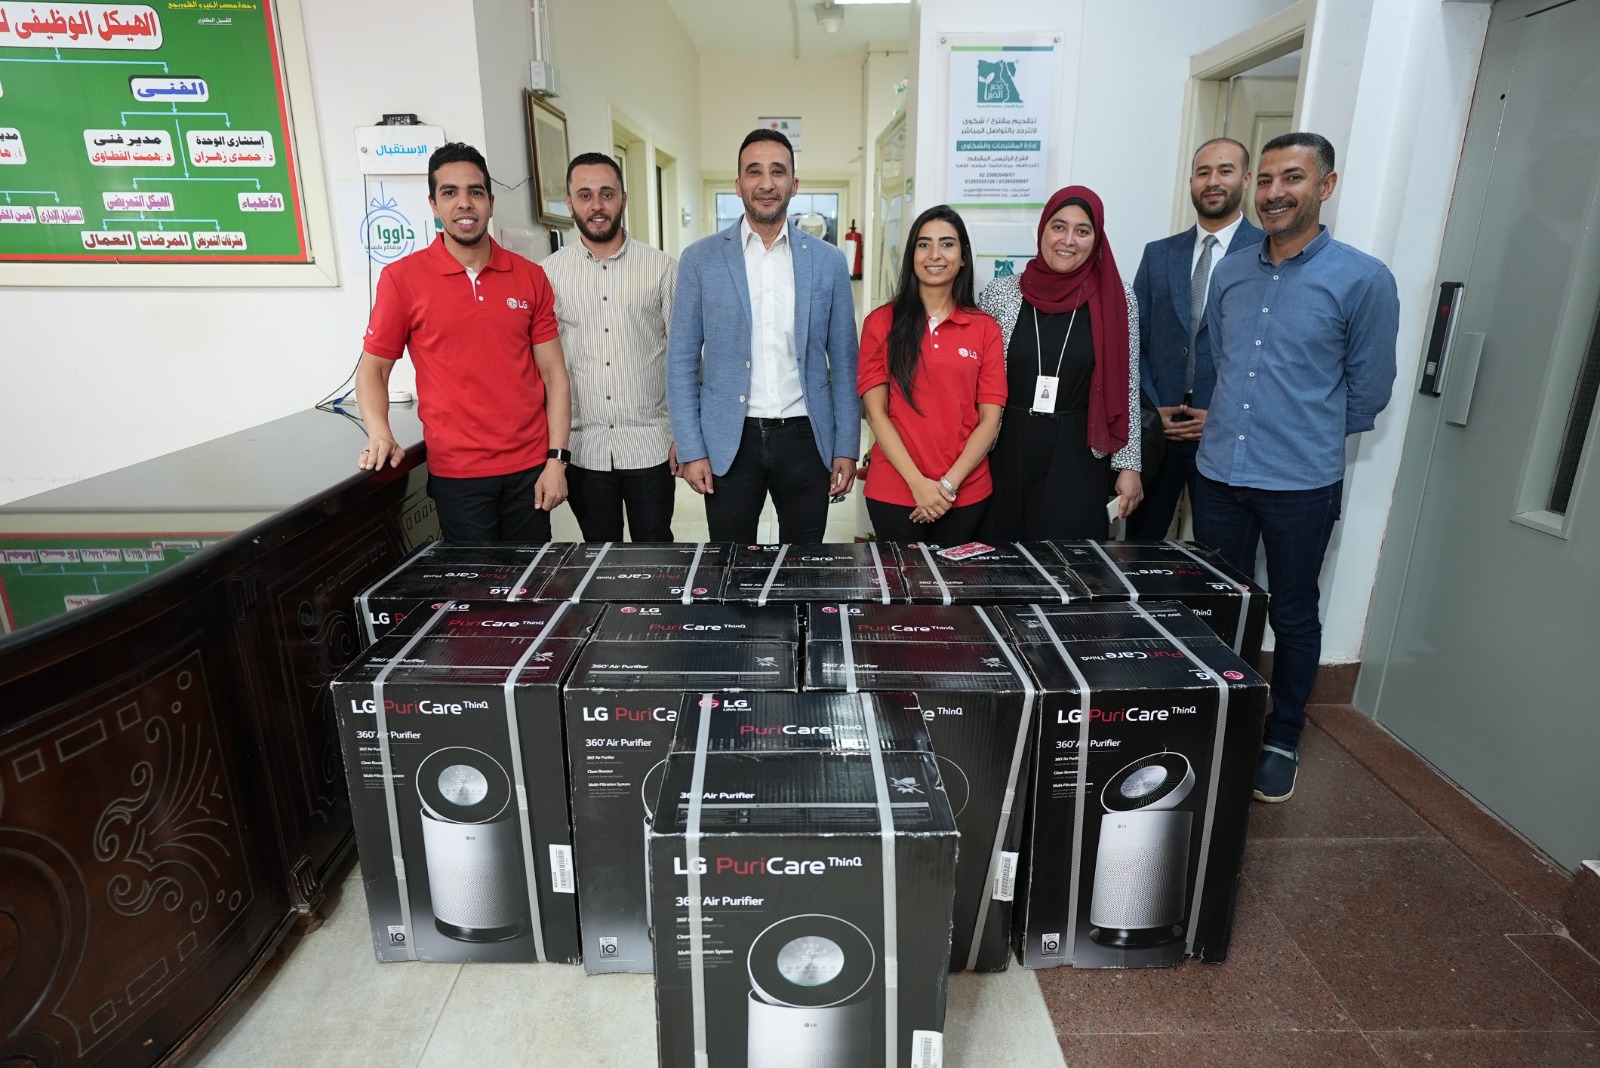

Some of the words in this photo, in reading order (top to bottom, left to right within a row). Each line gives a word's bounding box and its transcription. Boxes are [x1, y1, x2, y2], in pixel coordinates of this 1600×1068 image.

[14, 8, 93, 40] الوظيفى
[98, 10, 157, 42] الهيكل
[136, 82, 206, 98] الفنى
[962, 117, 984, 125] شكوى
[961, 126, 984, 135] المباشر
[93, 134, 124, 146] فنى
[127, 134, 162, 147] مدير
[196, 135, 225, 146] الوحدة
[226, 134, 264, 148] إستشارى
[960, 142, 990, 150] والشكاوى
[376, 144, 427, 156] الإستقبال
[194, 152, 227, 164] زهران
[229, 152, 262, 163] حمدى
[106, 195, 144, 210] التمريضى
[147, 195, 171, 210] الهيكل
[241, 196, 282, 210] الأطباء
[15, 206, 35, 222] أمين
[377, 224, 415, 244] داووا
[85, 234, 132, 248] العمال
[140, 234, 188, 247] الممرضات
[518, 300, 528, 309] LG
[968, 350, 978, 360] LG
[370, 612, 390, 624] LG
[448, 620, 519, 628] PuriCare
[1106, 651, 1184, 660] PuriCare
[351, 699, 376, 714] LG
[384, 700, 462, 715] PuriCare
[463, 701, 489, 709] ThinQ
[724, 700, 748, 708] LG
[583, 706, 608, 722] LG
[615, 707, 677, 722] PuriCa
[937, 707, 963, 716] ThinQ
[1057, 709, 1082, 724] LG
[1089, 708, 1169, 722] PuriCare
[1171, 706, 1197, 714] ThinQ
[356, 731, 376, 739] 360°
[390, 730, 421, 740] Purifier
[740, 725, 832, 735] PuriCare
[586, 738, 605, 747] 360°
[620, 738, 652, 747] Purifier
[1056, 740, 1075, 749] 360°
[1090, 739, 1121, 748] Purifier
[716, 857, 826, 875] PuriCare
[827, 857, 863, 868] ThinQ
[703, 896, 720, 906] Air
[722, 896, 764, 906] Purifier
